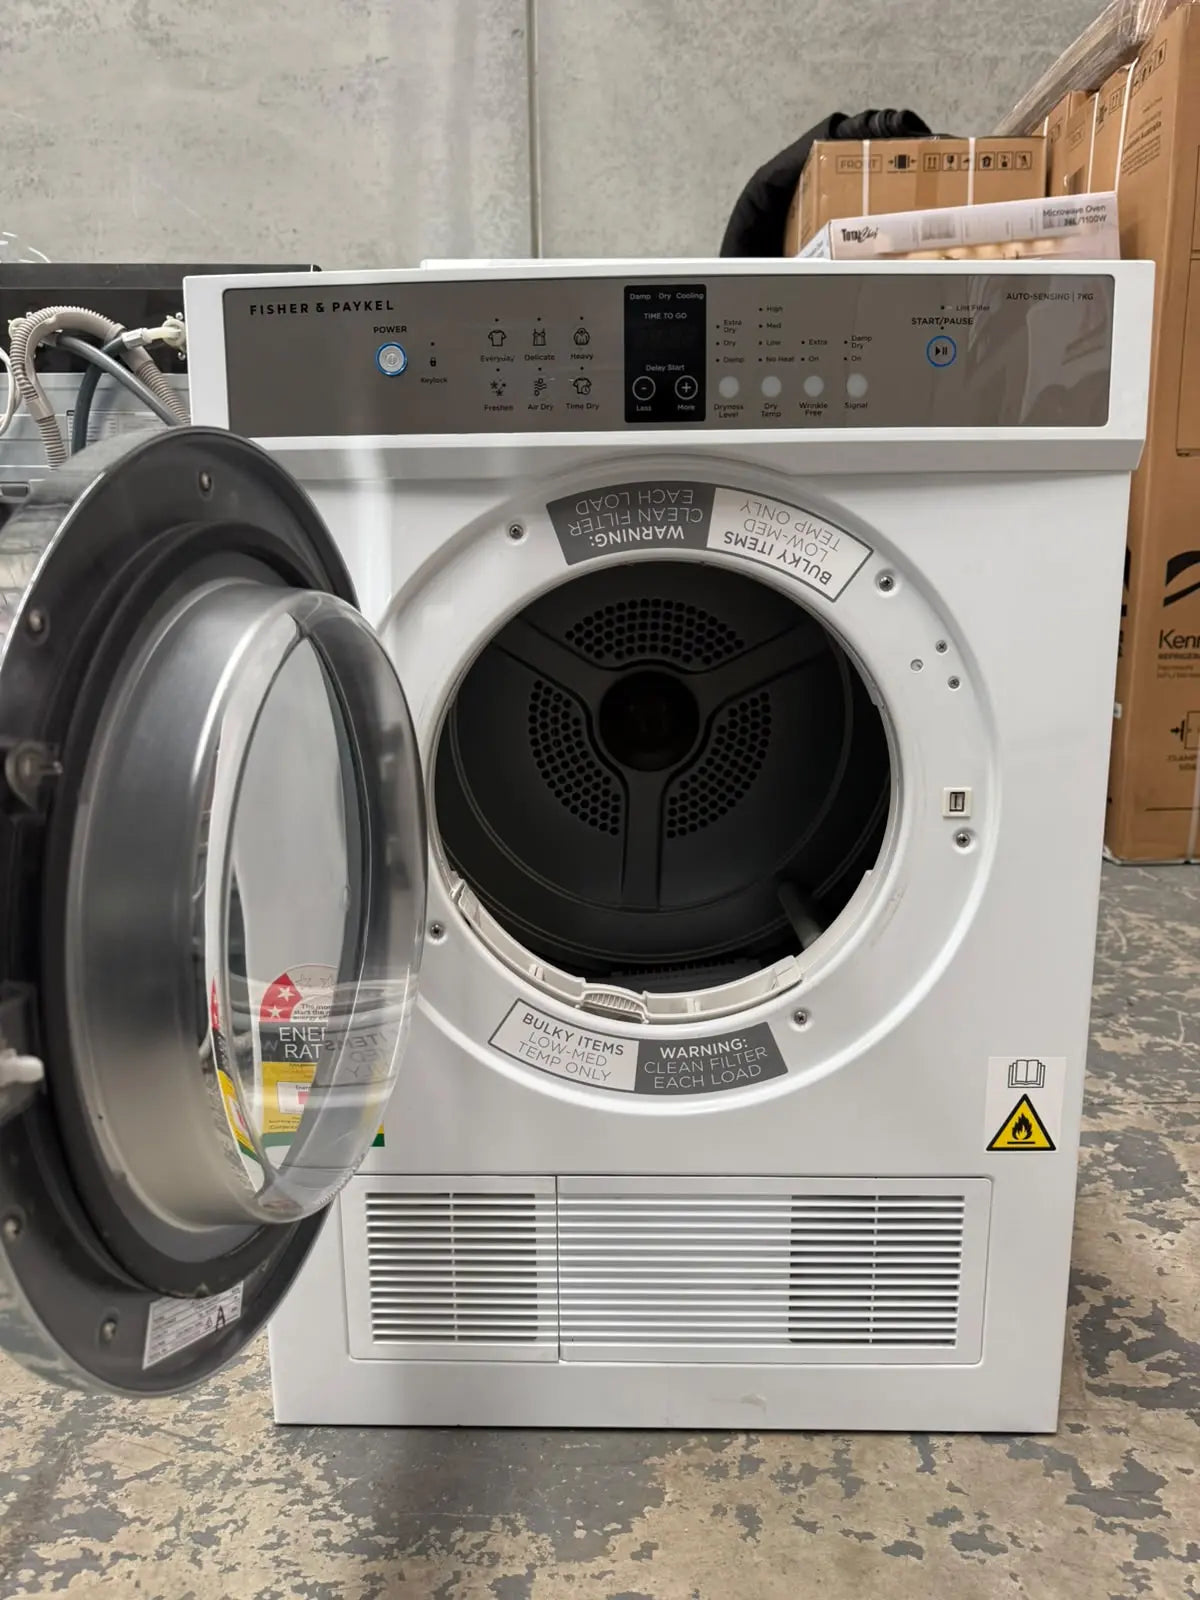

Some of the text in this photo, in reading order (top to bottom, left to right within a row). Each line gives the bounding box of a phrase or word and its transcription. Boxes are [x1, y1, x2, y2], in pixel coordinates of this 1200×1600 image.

[840, 159, 879, 170] FROT
[1043, 204, 1106, 217] Microwave Oven
[658, 292, 671, 300] Dry
[676, 292, 704, 300] Cooling
[1006, 292, 1094, 301] AUTO-SENSING 7KG
[250, 300, 394, 316] FISHER & PAYKEL
[643, 312, 661, 320] TIME
[911, 317, 974, 326] START/PAUSE
[373, 325, 407, 334] POWER
[645, 364, 665, 372] Delay
[540, 403, 553, 411] Dry
[586, 402, 600, 411] Dry
[713, 404, 744, 412] Dryness
[799, 401, 828, 409] Wrinkle
[844, 401, 869, 410] Signal
[761, 410, 782, 418] Temp
[575, 488, 695, 516] EACH LOAD
[569, 506, 704, 538] CLEAN FILTER
[740, 498, 842, 553] TEMP ONLY
[590, 525, 685, 548] WARNING:
[743, 517, 829, 563] LOW-MED
[723, 530, 833, 586] BULKY ITEMS
[521, 1011, 625, 1057] BULKY ITEMS
[527, 1030, 608, 1068] LOW-MED
[659, 1036, 749, 1061] WARNING:
[517, 1041, 613, 1083] TEMP ONLY
[643, 1044, 769, 1076] CLEAN FILTER
[653, 1062, 763, 1090] EACH LOAD
[215, 1304, 226, 1331] A
